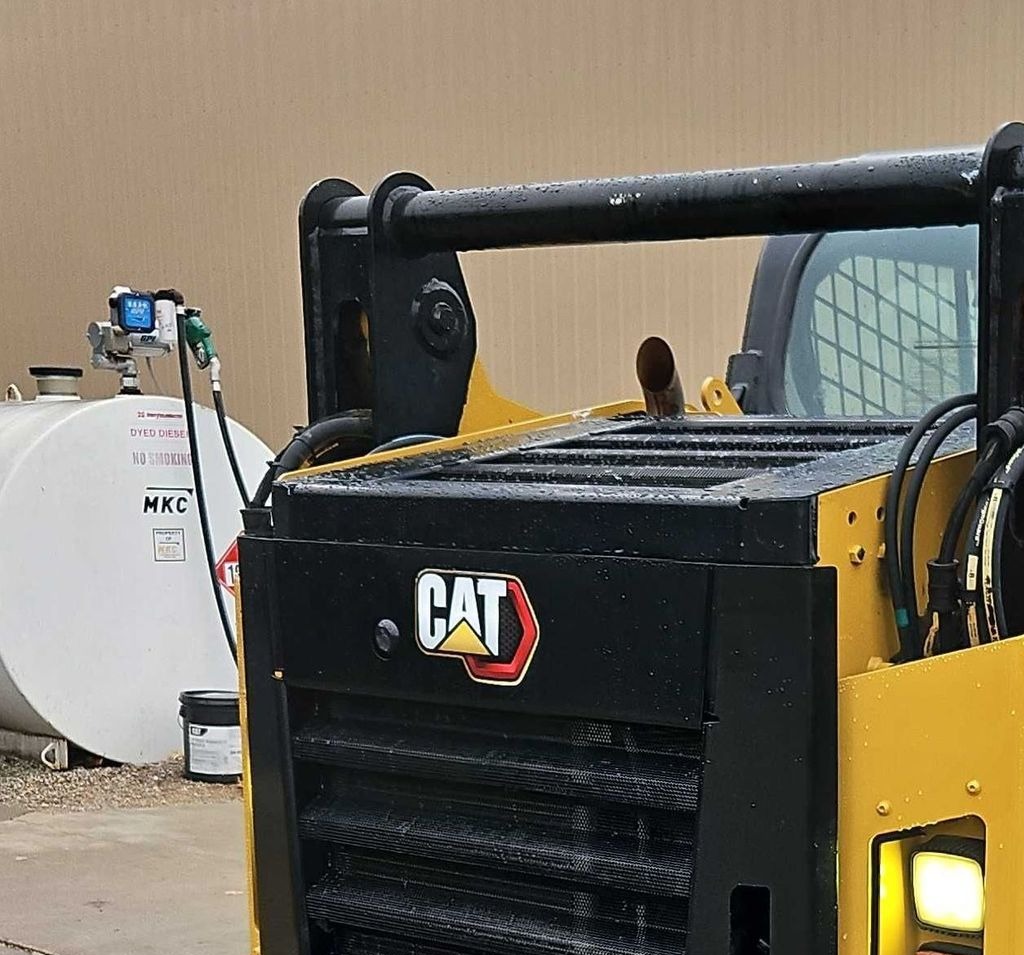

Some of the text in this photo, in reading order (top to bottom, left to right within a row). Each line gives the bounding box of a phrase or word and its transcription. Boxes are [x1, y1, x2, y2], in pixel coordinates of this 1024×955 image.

[130, 428, 156, 438] DYED
[132, 451, 146, 466] NO
[143, 495, 188, 514] MKC
[417, 572, 507, 657] CAT
